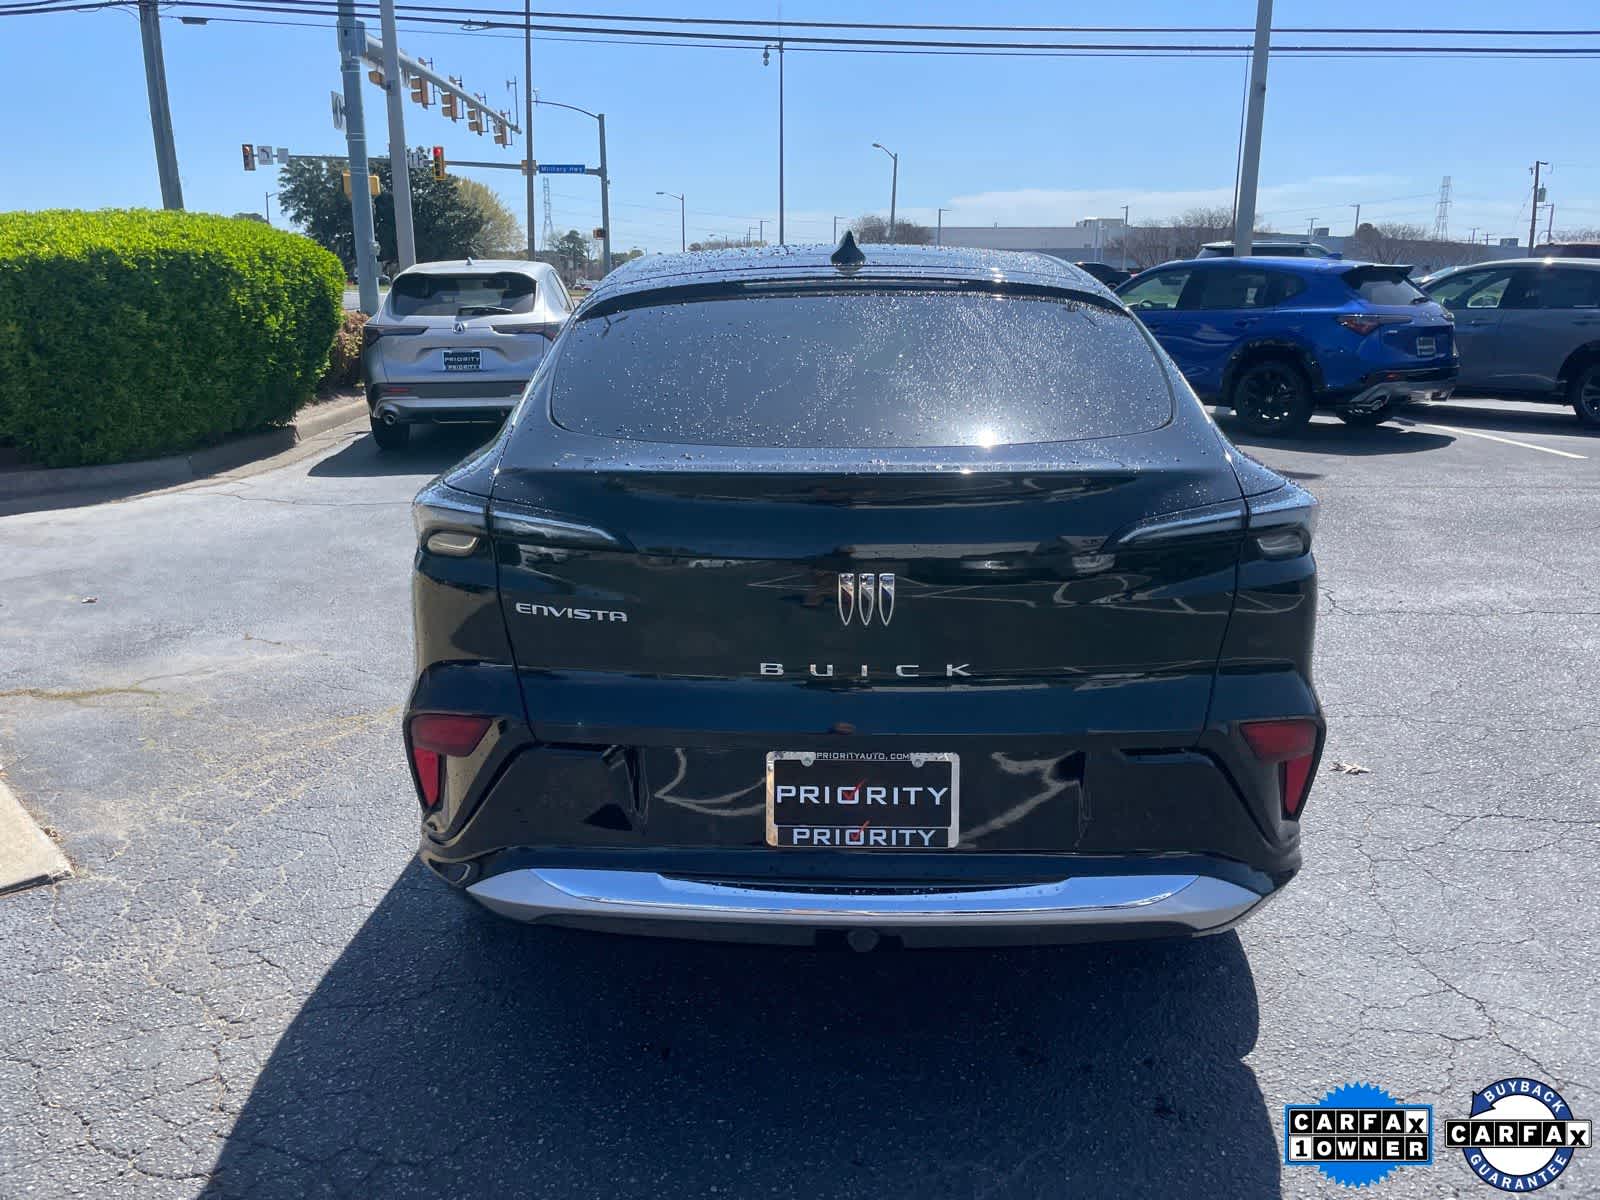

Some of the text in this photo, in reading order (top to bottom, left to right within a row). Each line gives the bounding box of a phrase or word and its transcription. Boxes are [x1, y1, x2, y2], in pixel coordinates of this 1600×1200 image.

[515, 602, 628, 622] ENVISTA
[759, 662, 972, 677] BUICK
[776, 785, 948, 805] PRIORITY
[792, 828, 936, 846] PRIORITY
